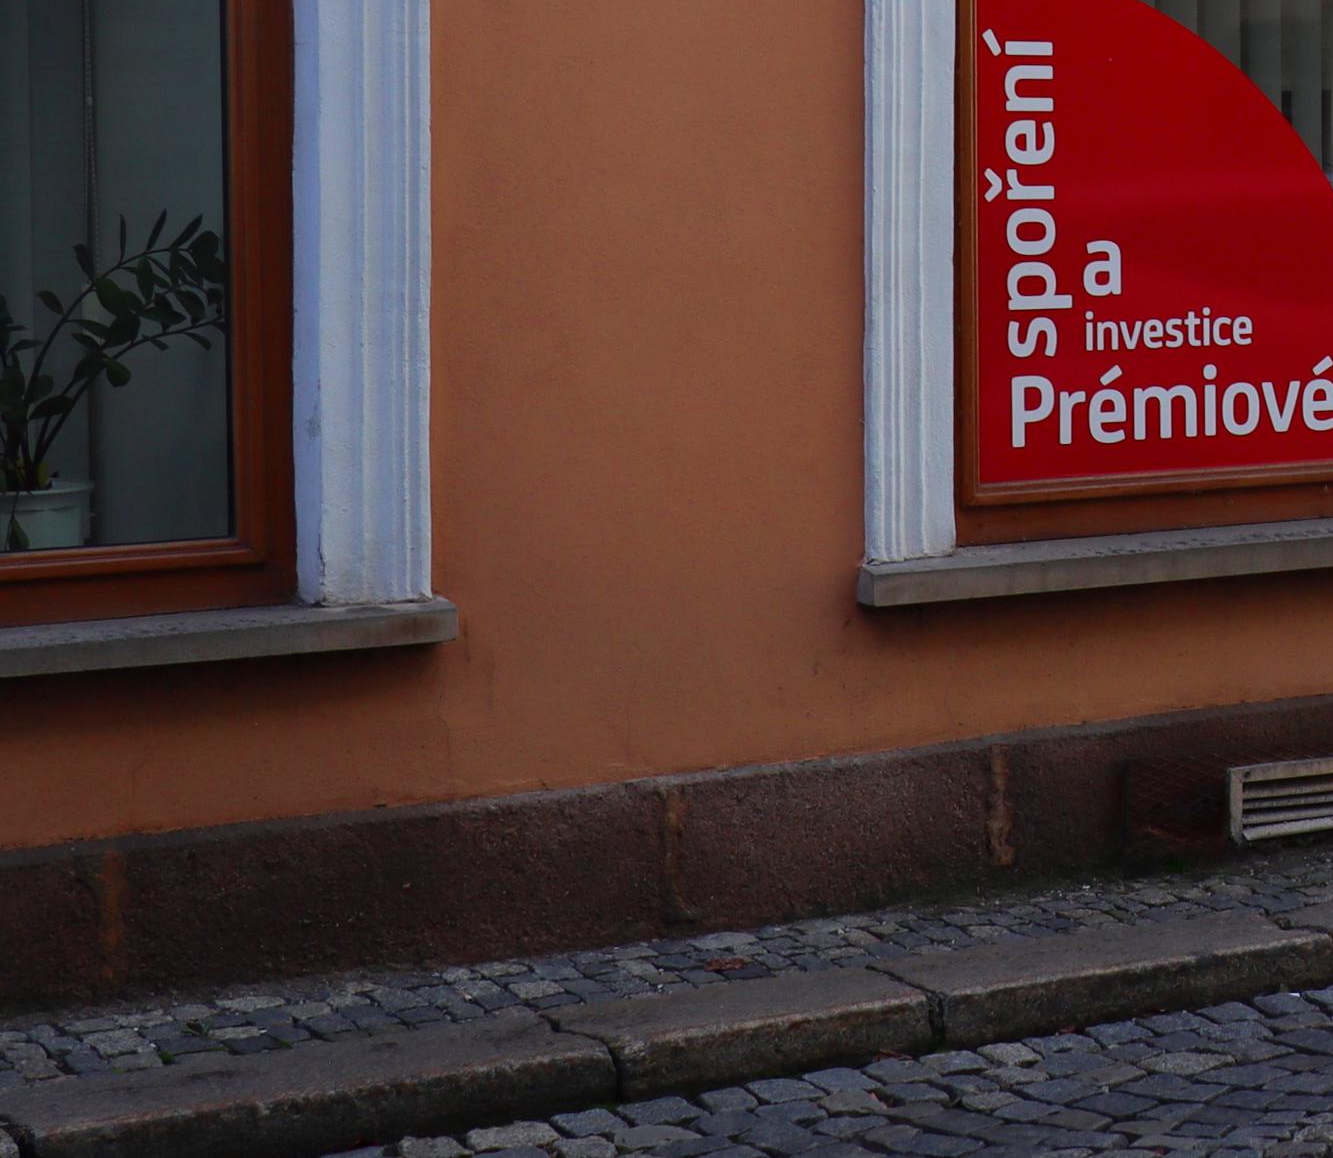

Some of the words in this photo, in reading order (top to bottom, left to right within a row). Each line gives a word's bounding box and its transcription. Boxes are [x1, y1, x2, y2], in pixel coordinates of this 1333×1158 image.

[982, 28, 1073, 359] spoření
[1083, 239, 1123, 298] a
[1085, 307, 1254, 352] investice
